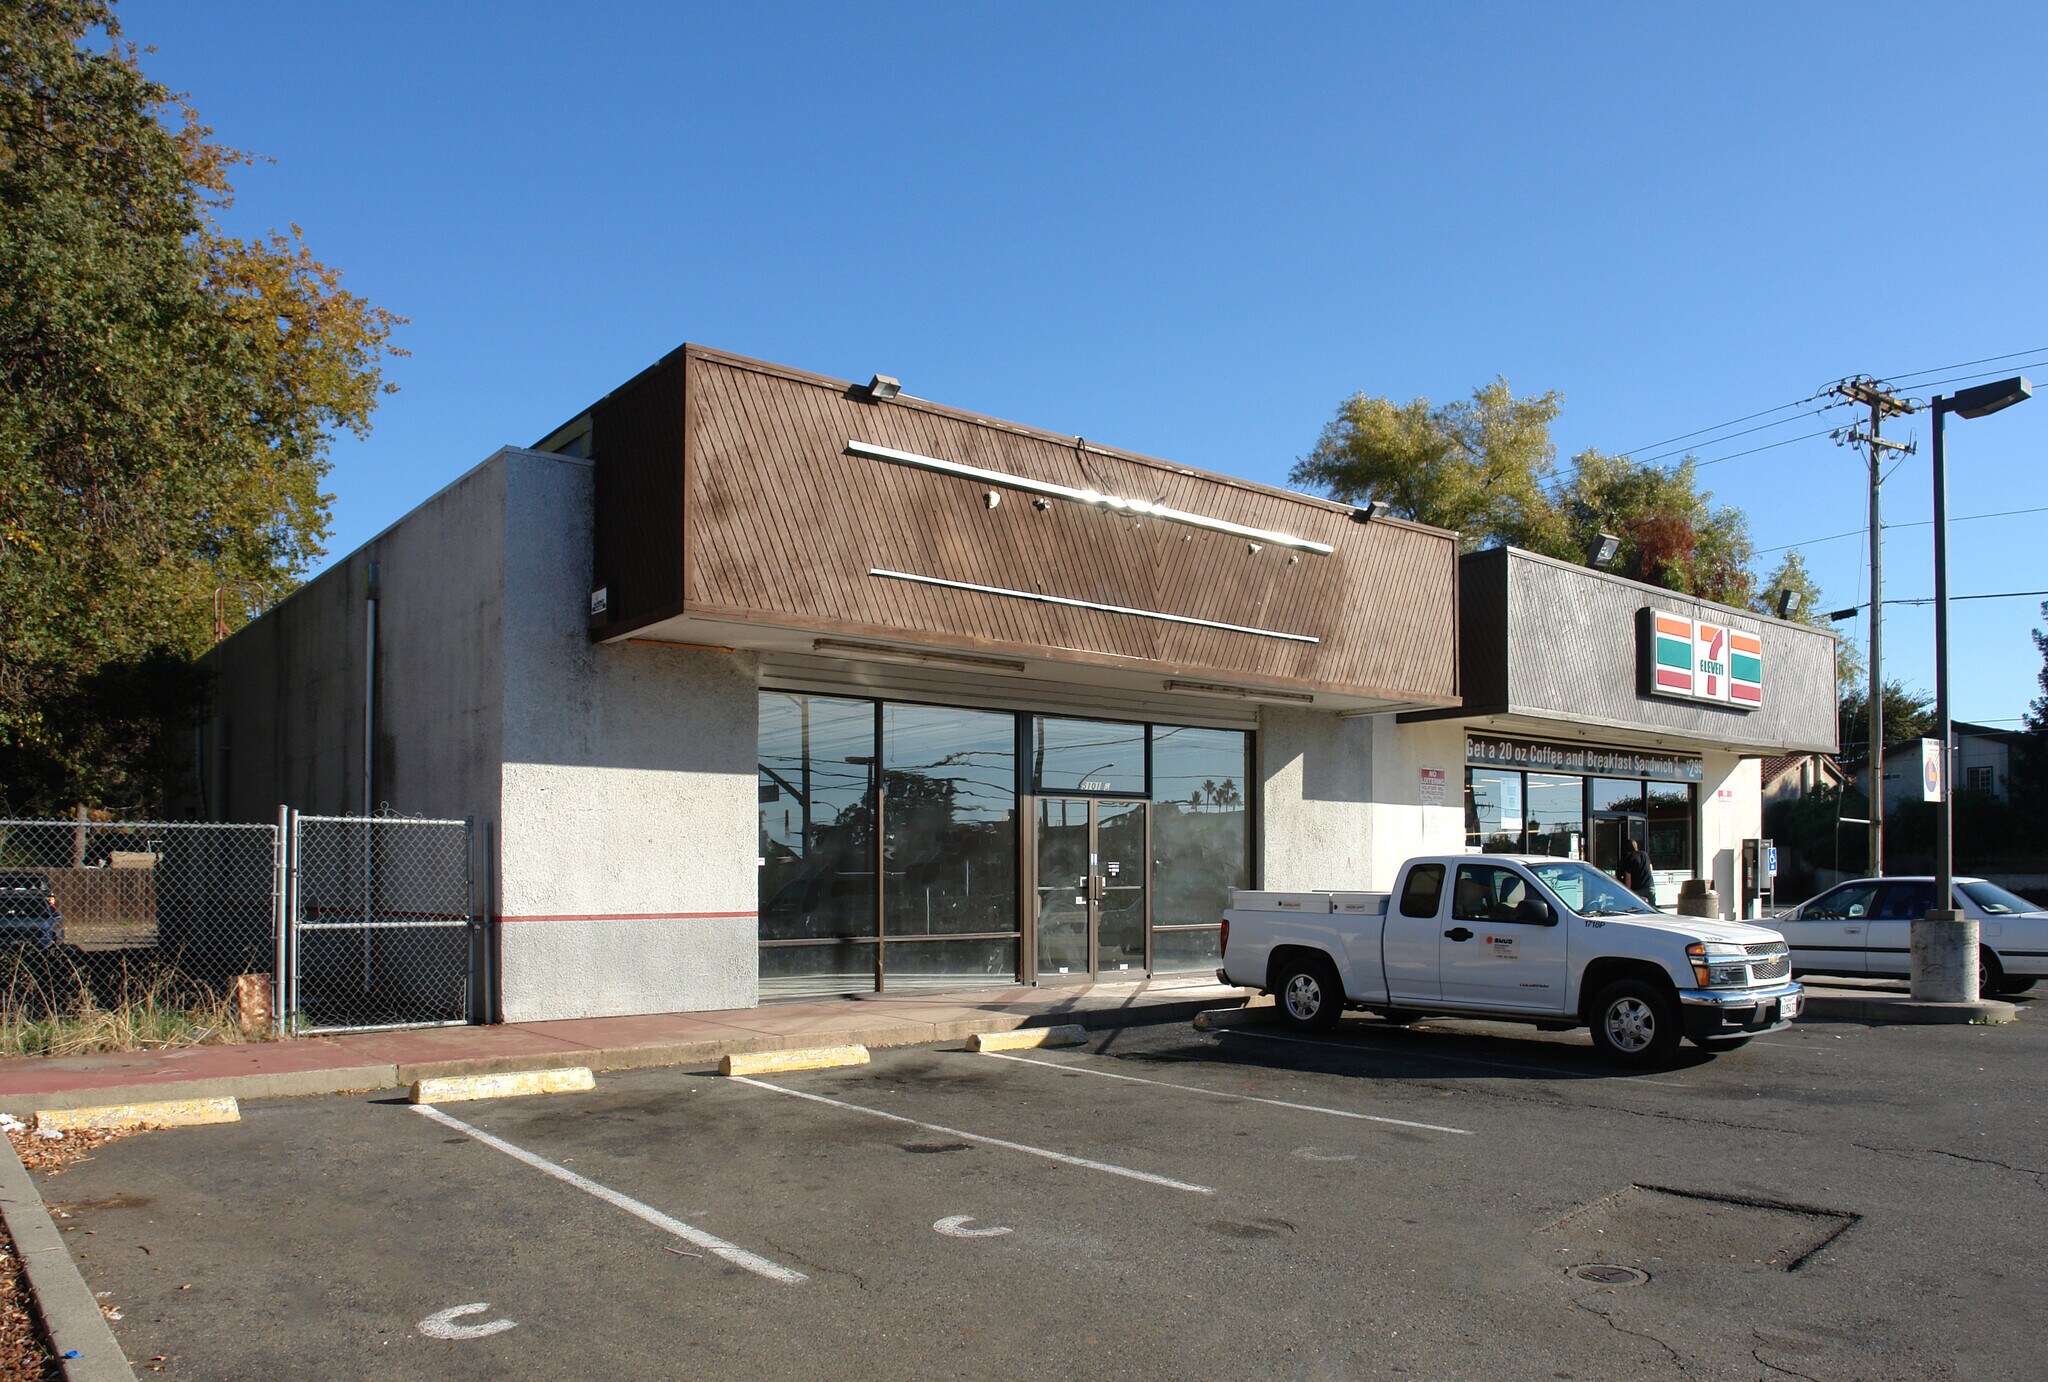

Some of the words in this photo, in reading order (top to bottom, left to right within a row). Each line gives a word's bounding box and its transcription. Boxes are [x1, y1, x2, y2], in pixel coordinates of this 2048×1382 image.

[1700, 625, 1723, 696] 7
[1467, 738, 1486, 758] Get
[1488, 744, 1496, 759] a
[1499, 742, 1512, 760] 20
[1514, 747, 1527, 762] oz
[1530, 744, 1563, 765] Coffee
[1565, 750, 1584, 766] and
[1587, 750, 1632, 771] Breakfast
[1634, 754, 1673, 774] Sandwich
[1584, 920, 1605, 929] 1718P
